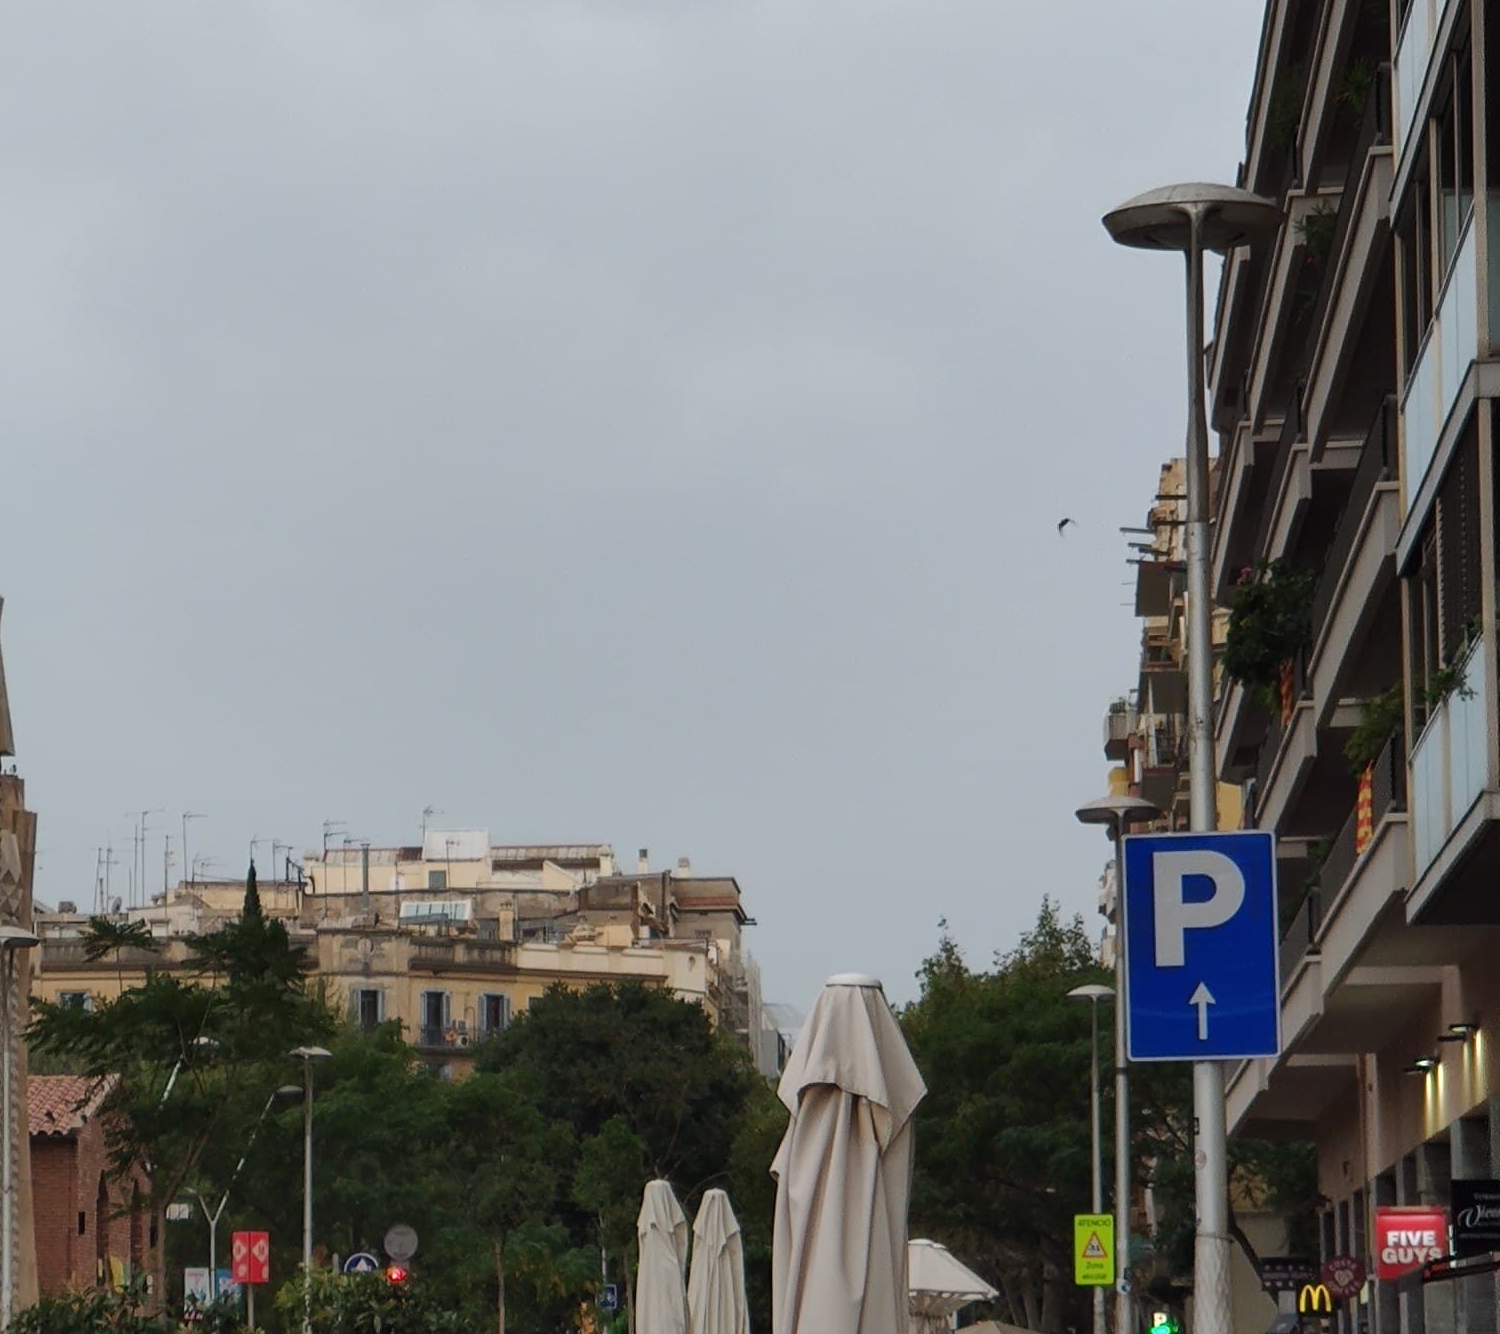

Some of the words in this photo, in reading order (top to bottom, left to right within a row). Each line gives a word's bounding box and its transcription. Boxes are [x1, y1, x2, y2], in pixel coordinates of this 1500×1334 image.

[1153, 850, 1246, 967] P
[1386, 1230, 1437, 1247] FIVE
[1381, 1247, 1442, 1265] GUYS
